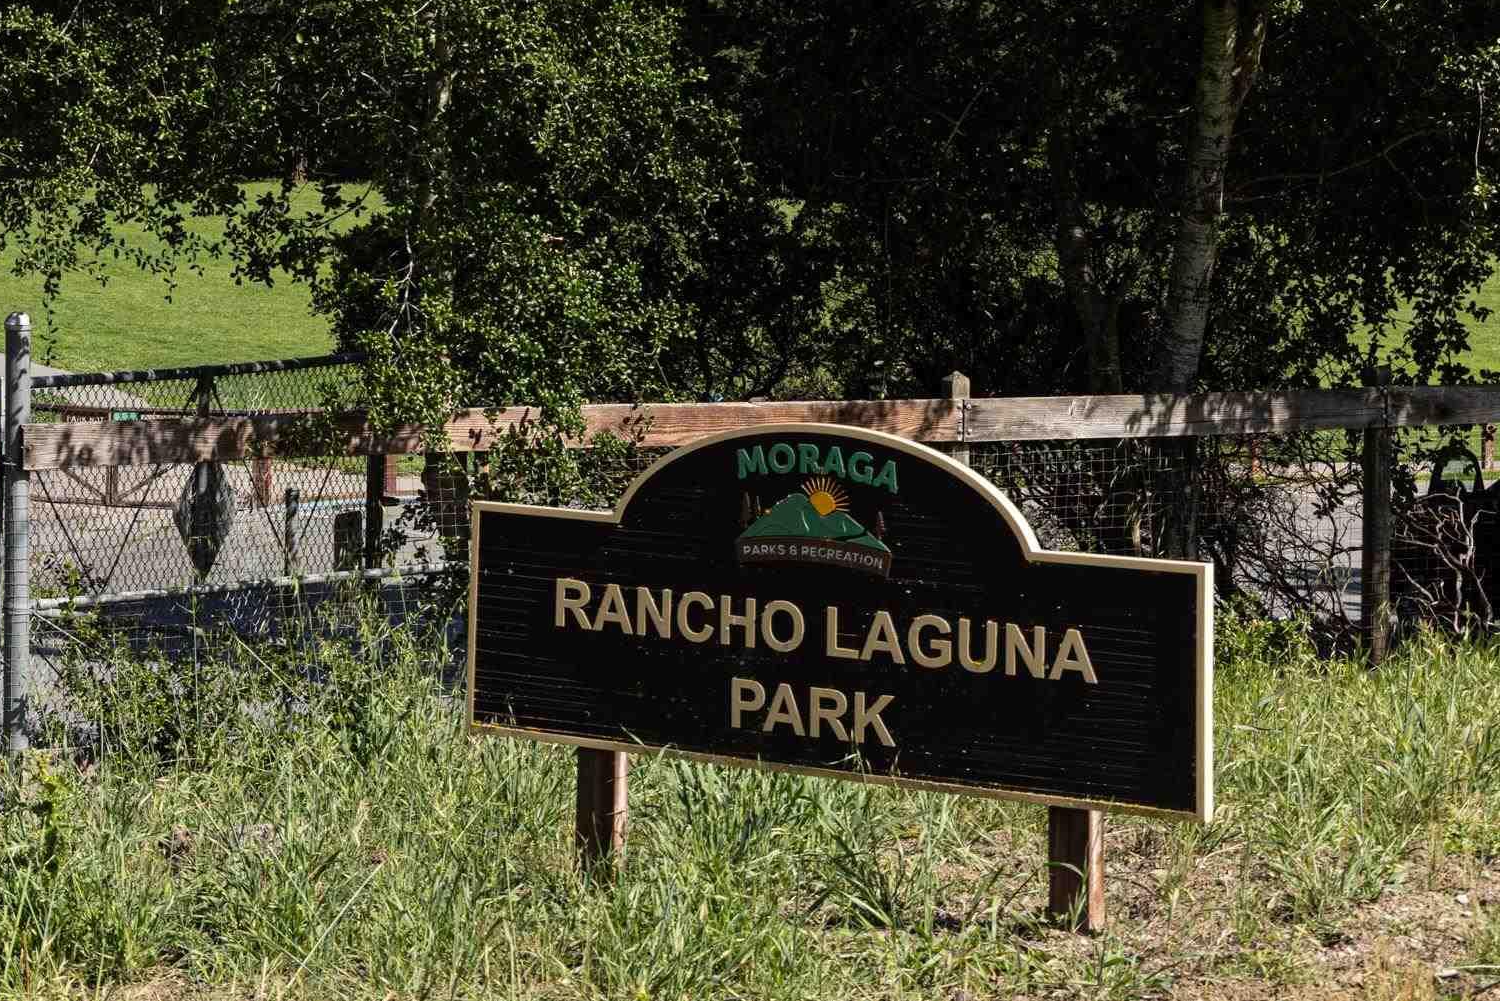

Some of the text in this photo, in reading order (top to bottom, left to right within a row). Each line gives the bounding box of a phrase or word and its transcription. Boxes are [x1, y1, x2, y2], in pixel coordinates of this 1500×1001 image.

[736, 442, 898, 494] MORAGA
[743, 544, 884, 569] PARKS & RECREATION
[554, 577, 1099, 685] RANCHO LAGUNA
[730, 676, 897, 749] PARK
